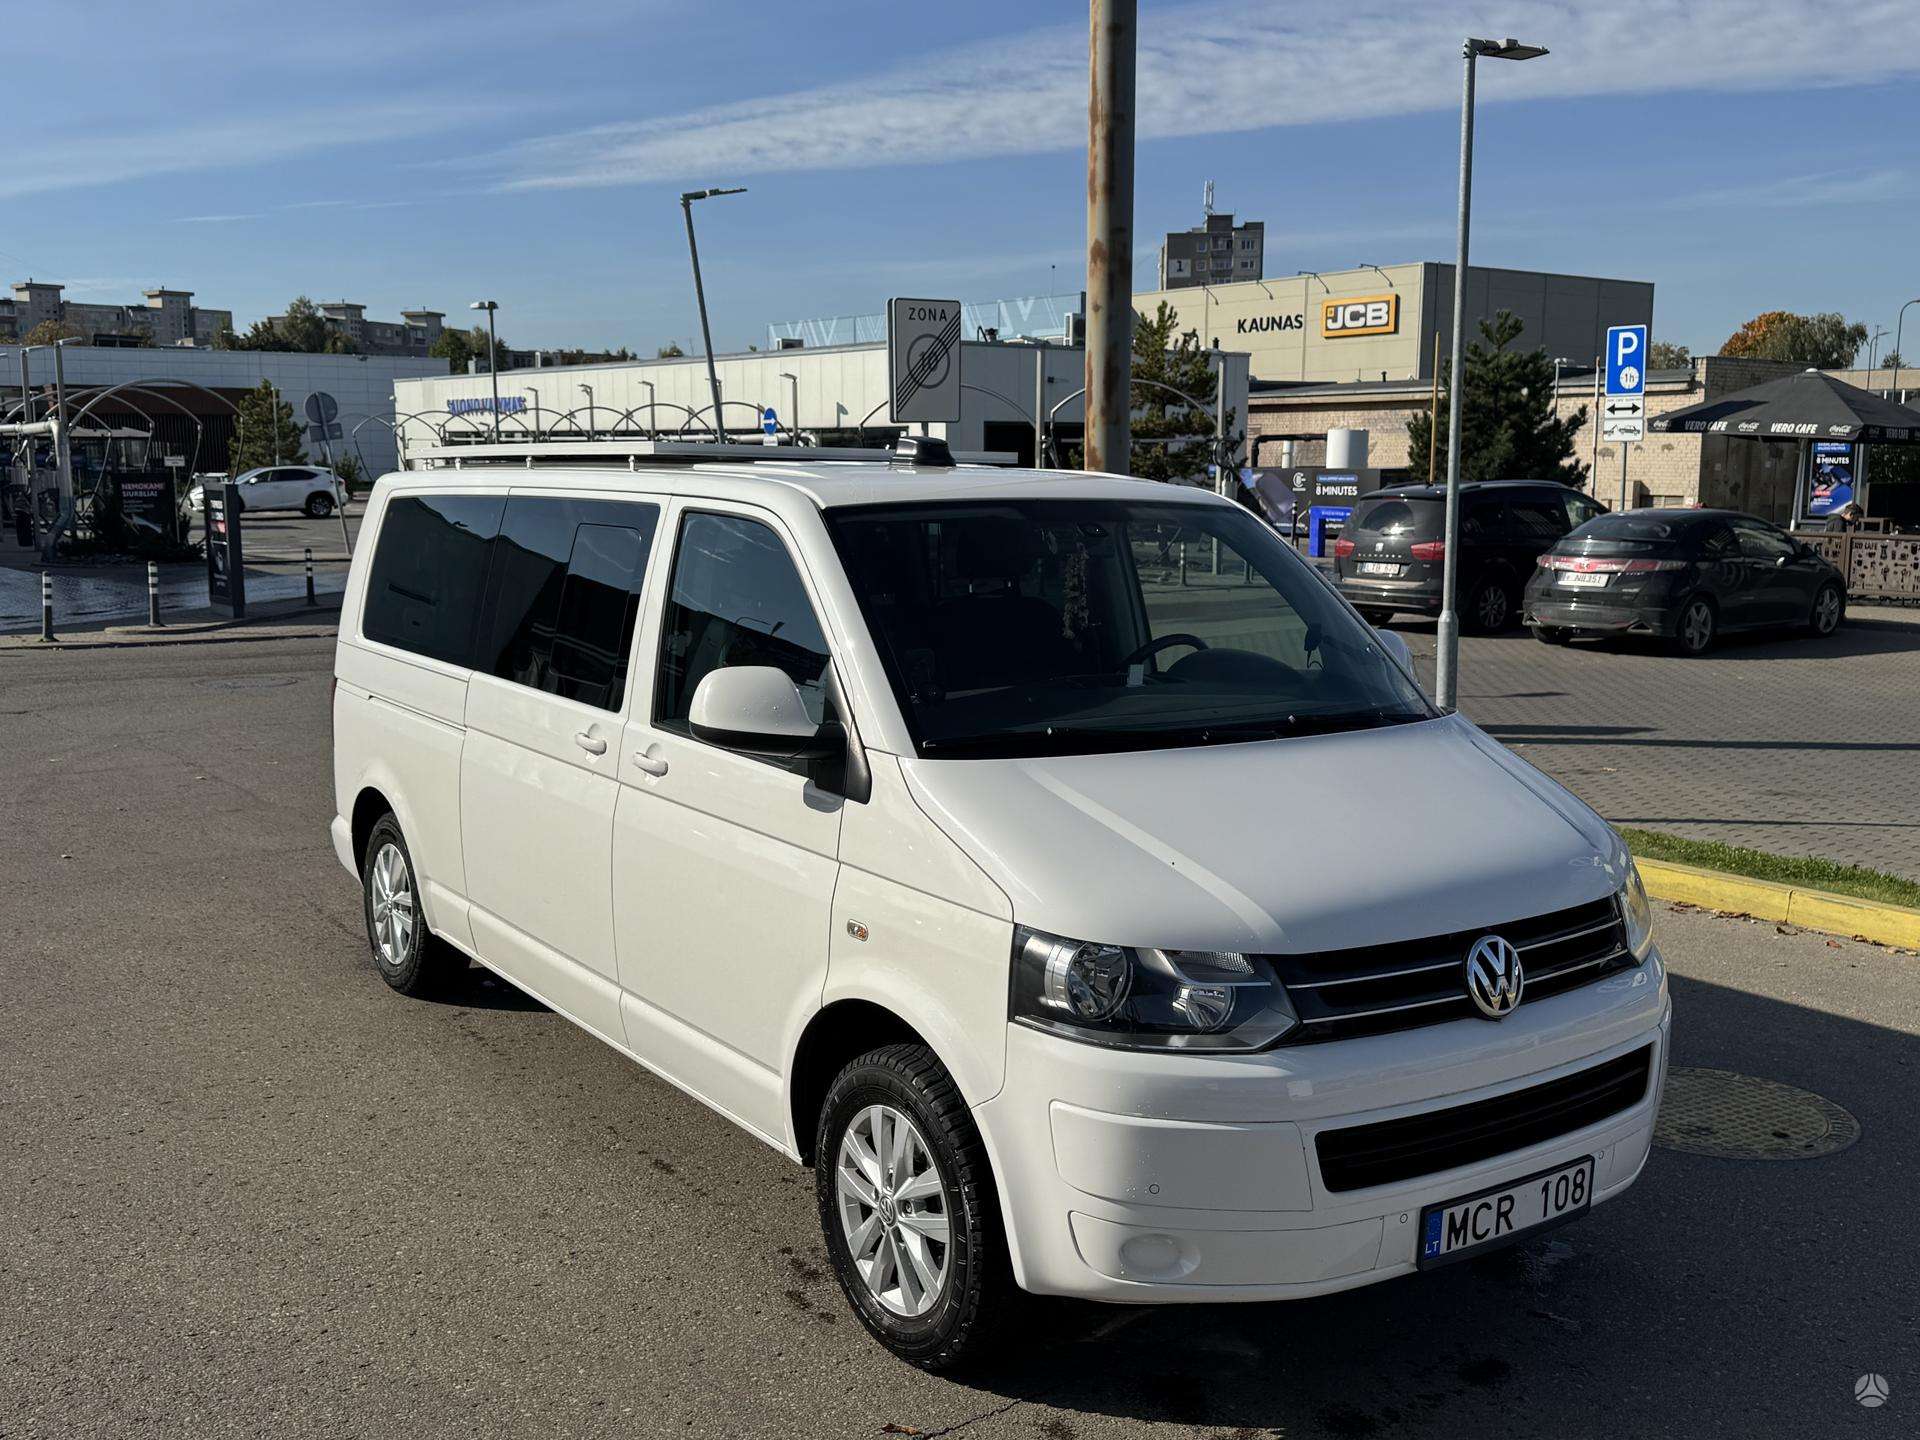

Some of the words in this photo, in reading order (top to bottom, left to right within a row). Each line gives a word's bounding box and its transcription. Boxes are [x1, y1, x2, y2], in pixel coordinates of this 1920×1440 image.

[908, 307, 948, 321] ZONA
[1326, 302, 1389, 330] JCB
[1237, 314, 1303, 334] KAUNAS
[1617, 331, 1638, 366] P
[1684, 420, 1706, 431] VERO
[1707, 421, 1729, 431] CAFE
[1770, 422, 1795, 433] VERO
[1795, 423, 1818, 434] CAFE
[1315, 486, 1322, 496] 8
[1322, 486, 1358, 496] MINUTES
[1425, 1240, 1440, 1254] LT
[1446, 1194, 1515, 1250] MCR
[1541, 1168, 1586, 1218] 108
